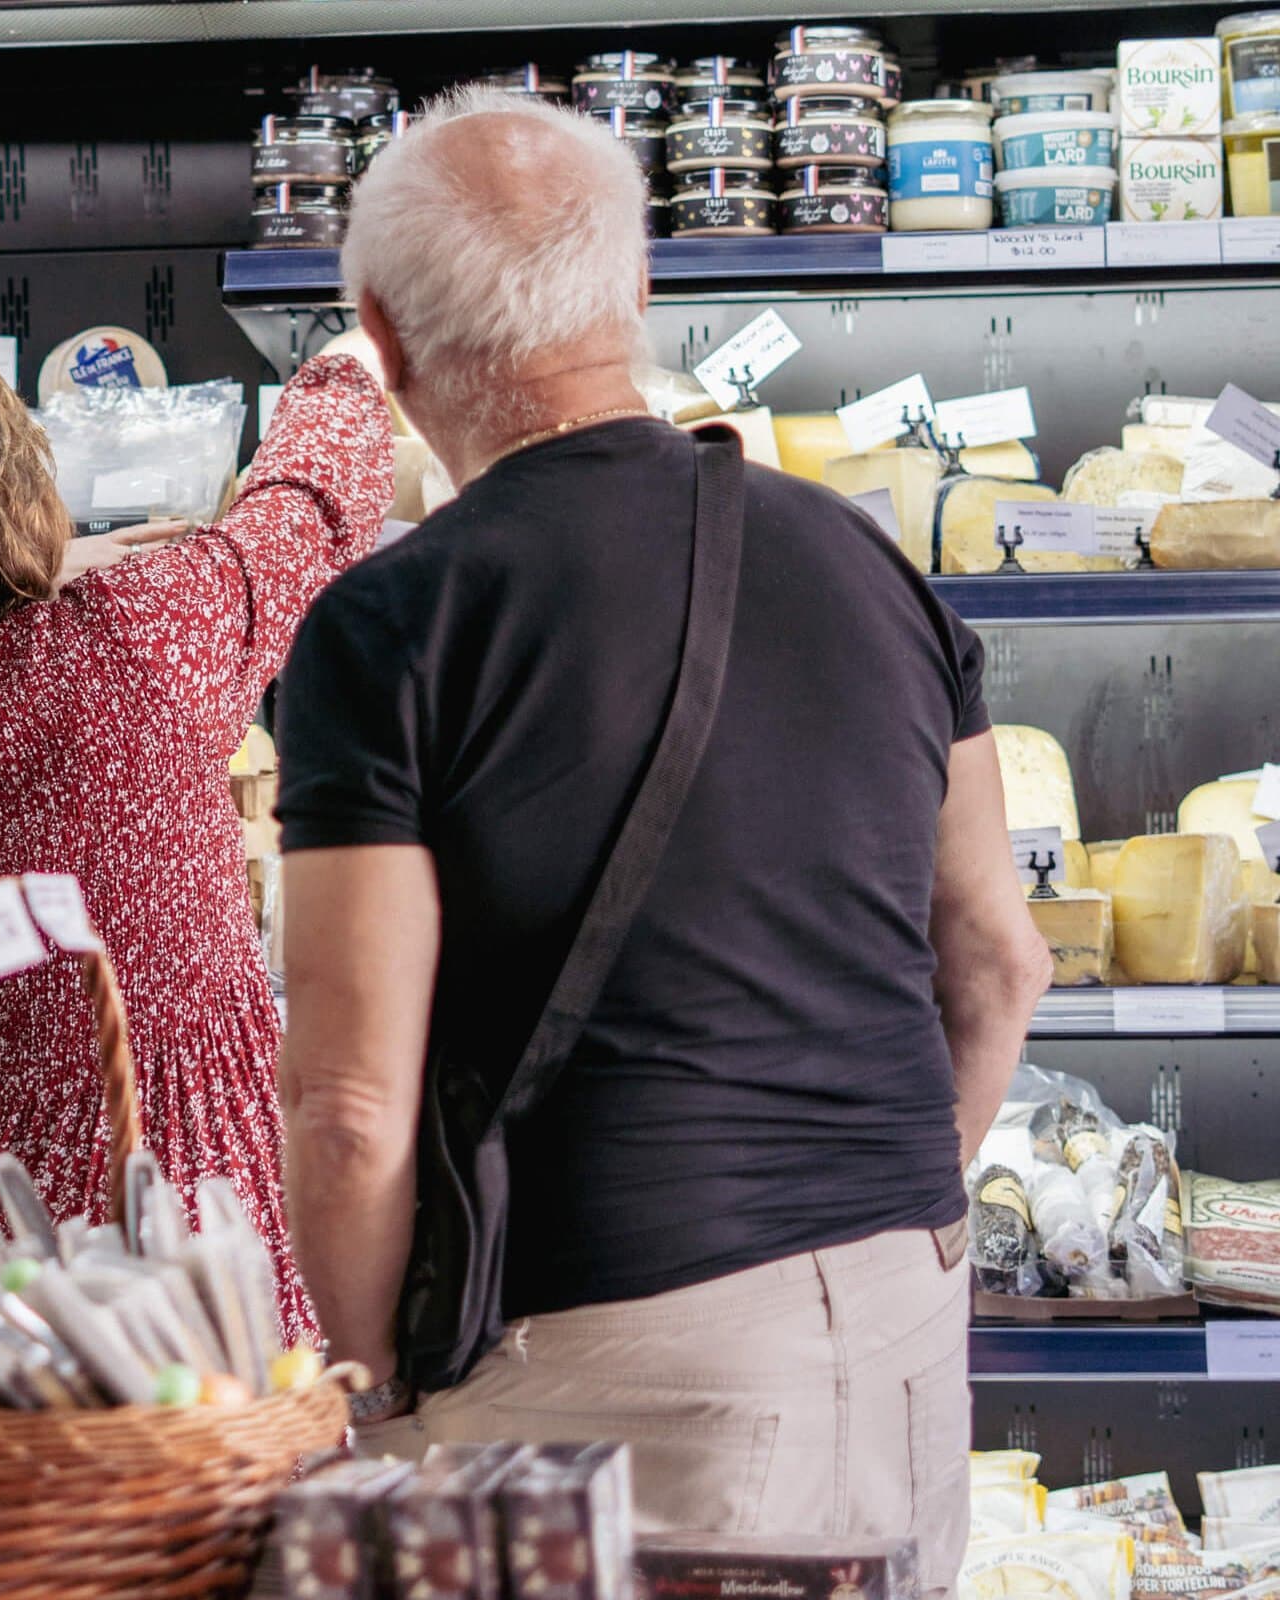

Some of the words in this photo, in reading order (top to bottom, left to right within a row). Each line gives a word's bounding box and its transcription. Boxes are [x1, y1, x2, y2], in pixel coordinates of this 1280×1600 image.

[1127, 65, 1214, 88] Boursin
[704, 128, 727, 137] CRAFT
[923, 156, 957, 167] LAFITTE
[1044, 148, 1086, 164] LARD
[1130, 160, 1216, 184] Boursin
[705, 199, 728, 207] CRAFT
[1055, 206, 1094, 220] LARD
[95, 348, 131, 370] FRANCE
[89, 521, 111, 529] CRAFT
[721, 1579, 807, 1597] Marshmallow
